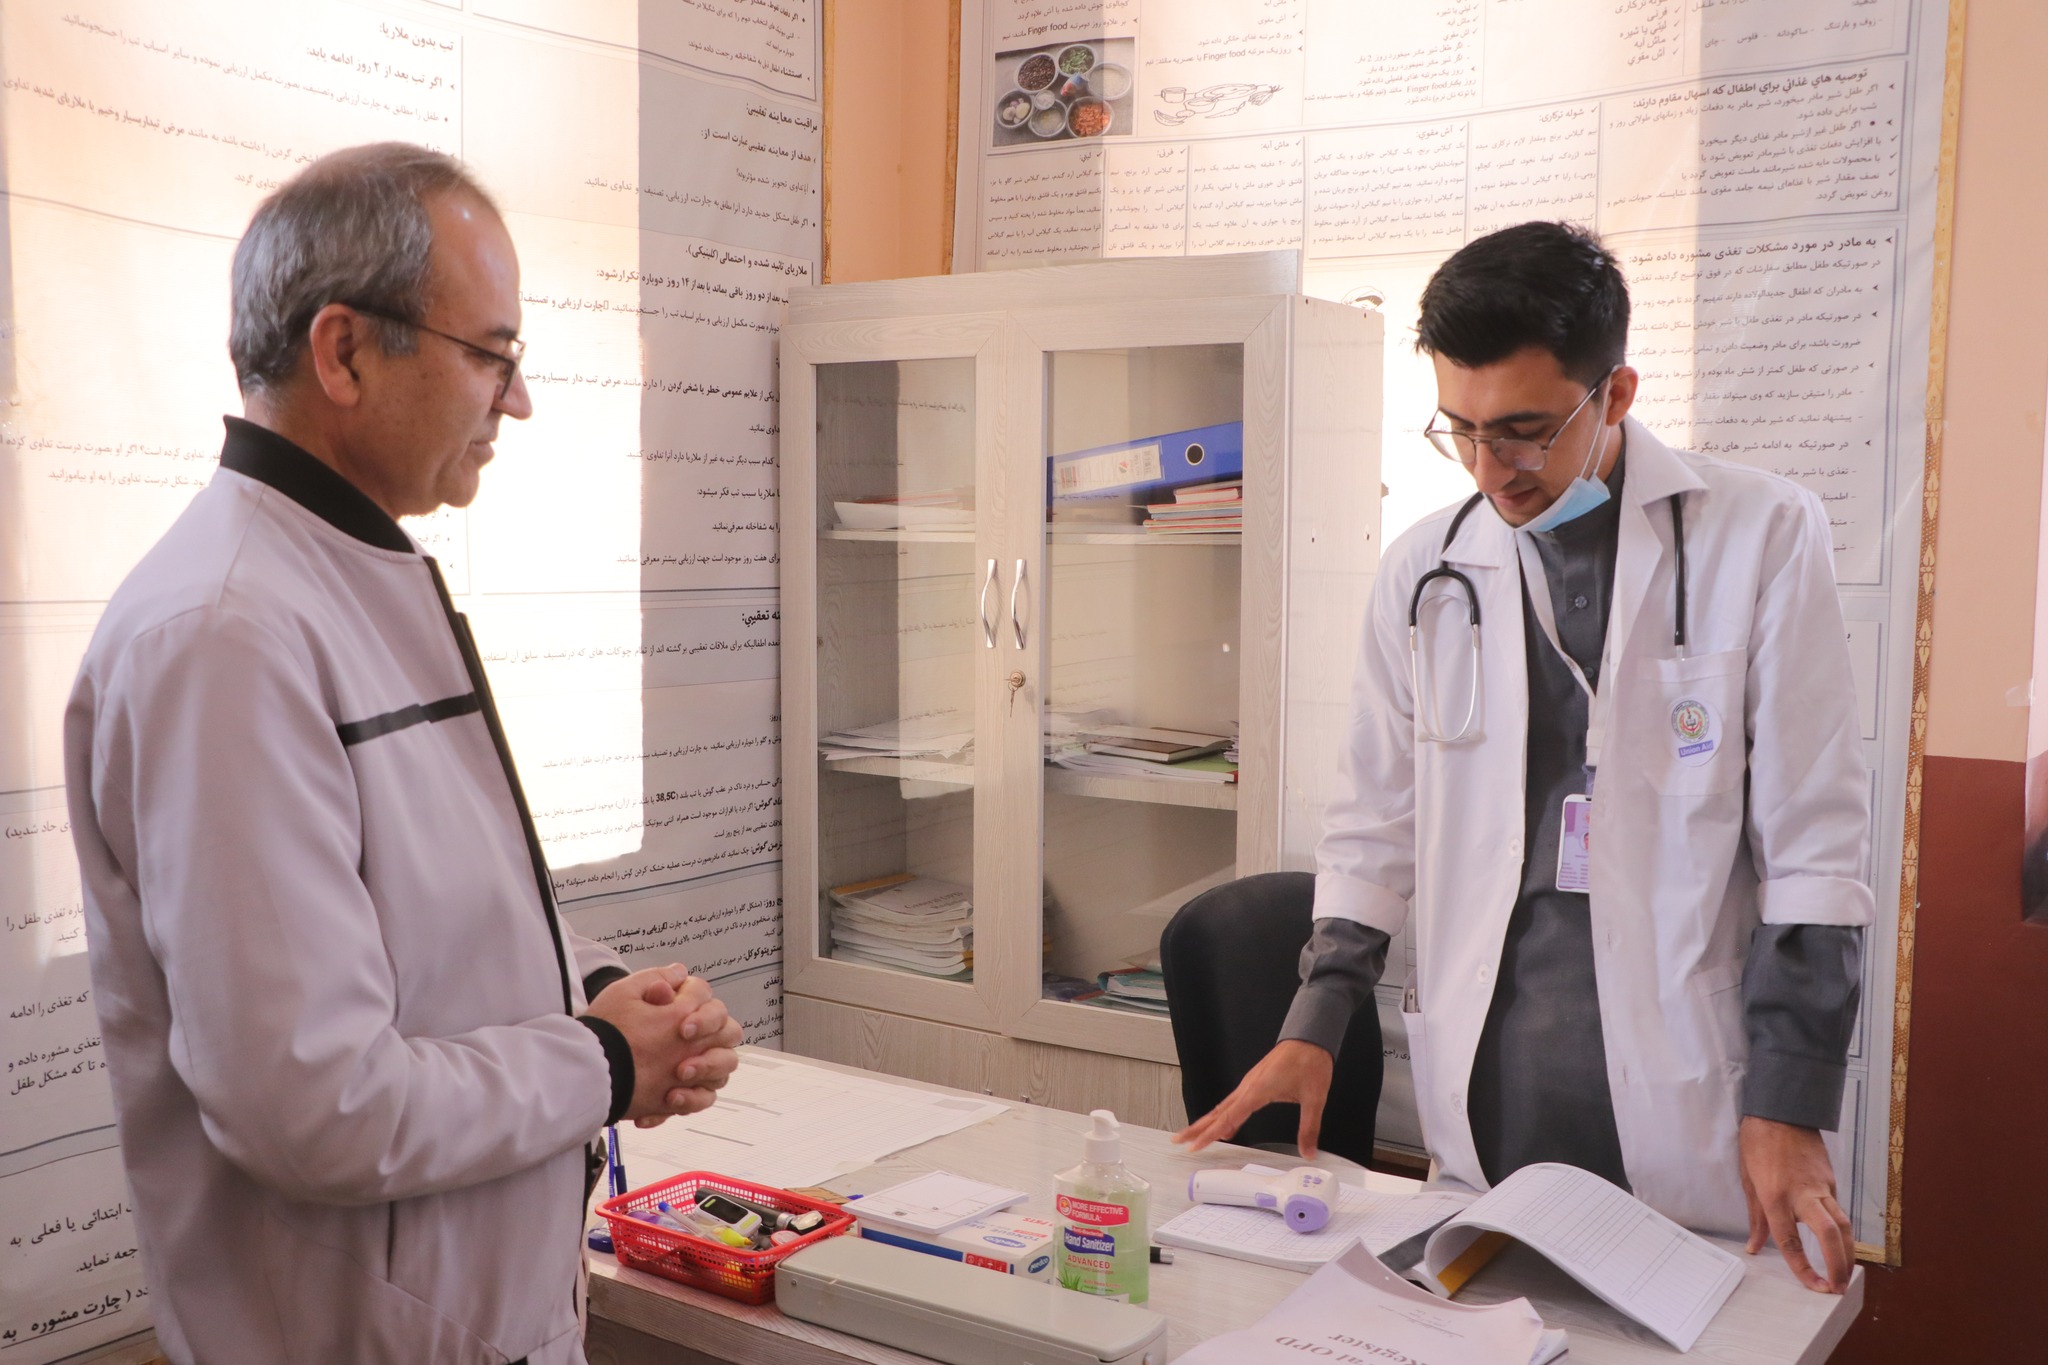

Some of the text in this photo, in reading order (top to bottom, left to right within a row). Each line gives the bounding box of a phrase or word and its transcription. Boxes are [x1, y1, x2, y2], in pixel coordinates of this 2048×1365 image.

[1028, 26, 1048, 35] Finger
[1050, 22, 1067, 30] food
[412, 36, 436, 49] بدون
[439, 40, 454, 52] تب
[331, 53, 353, 64] ادامه
[1203, 49, 1246, 61] Finger food
[356, 58, 371, 74] روز
[384, 66, 391, 78] از
[394, 71, 408, 82] بعد
[412, 75, 424, 86] تب
[1835, 68, 1867, 84] توصیه
[429, 77, 442, 89] اگر
[1406, 81, 1447, 94] Finger food
[1727, 83, 1756, 95] اطفال
[1712, 84, 1726, 95] که
[769, 112, 792, 124] معاینه
[1817, 108, 1832, 116] داده
[795, 118, 817, 133] مراقبت
[712, 131, 730, 140] است
[768, 147, 789, 157] معاینه
[1746, 243, 1788, 254] مشکلات
[1792, 243, 1817, 252] مورد
[1821, 241, 1834, 251] در
[1839, 237, 1861, 251] مادر
[1866, 239, 1876, 248] به
[1656, 251, 1676, 261] داده
[1715, 247, 1742, 260] تغذی
[29, 437, 53, 451] تداوی
[56, 441, 81, 453] درست
[84, 444, 112, 455] بصورت
[1700, 441, 1719, 453] دیگر
[1722, 442, 1739, 452] های
[1742, 442, 1758, 453] شیر
[1762, 440, 1781, 449] ادامه
[1838, 442, 1848, 451] در
[125, 444, 137, 457] اگر
[184, 449, 203, 461] تداوی
[98, 475, 106, 483] به
[118, 473, 141, 485] تداوی
[144, 476, 168, 487] درست
[171, 476, 188, 488] شکل
[42, 821, 57, 832] حاد
[6, 908, 65, 932] تغذی طفل را
[77, 991, 89, 1002] که
[10, 1004, 35, 1018] ادامه
[47, 997, 72, 1013] تغذی
[74, 1037, 100, 1054] تغذی
[18, 1052, 38, 1066] داده
[42, 1046, 69, 1062] مشوره
[11, 1061, 95, 1095] تا که مشکل طفل
[1089, 1203, 1124, 1215] EFFECTIVE
[66, 1217, 76, 1232] یا
[31, 1220, 62, 1244] فعلی
[10, 1236, 22, 1248] به
[1065, 1233, 1114, 1251] Hand Sanitizer
[1067, 1255, 1110, 1269] ADVANCED
[31, 1309, 79, 1334] مشوره
[2, 1329, 16, 1341] به
[1275, 1336, 1333, 1356] OPD
